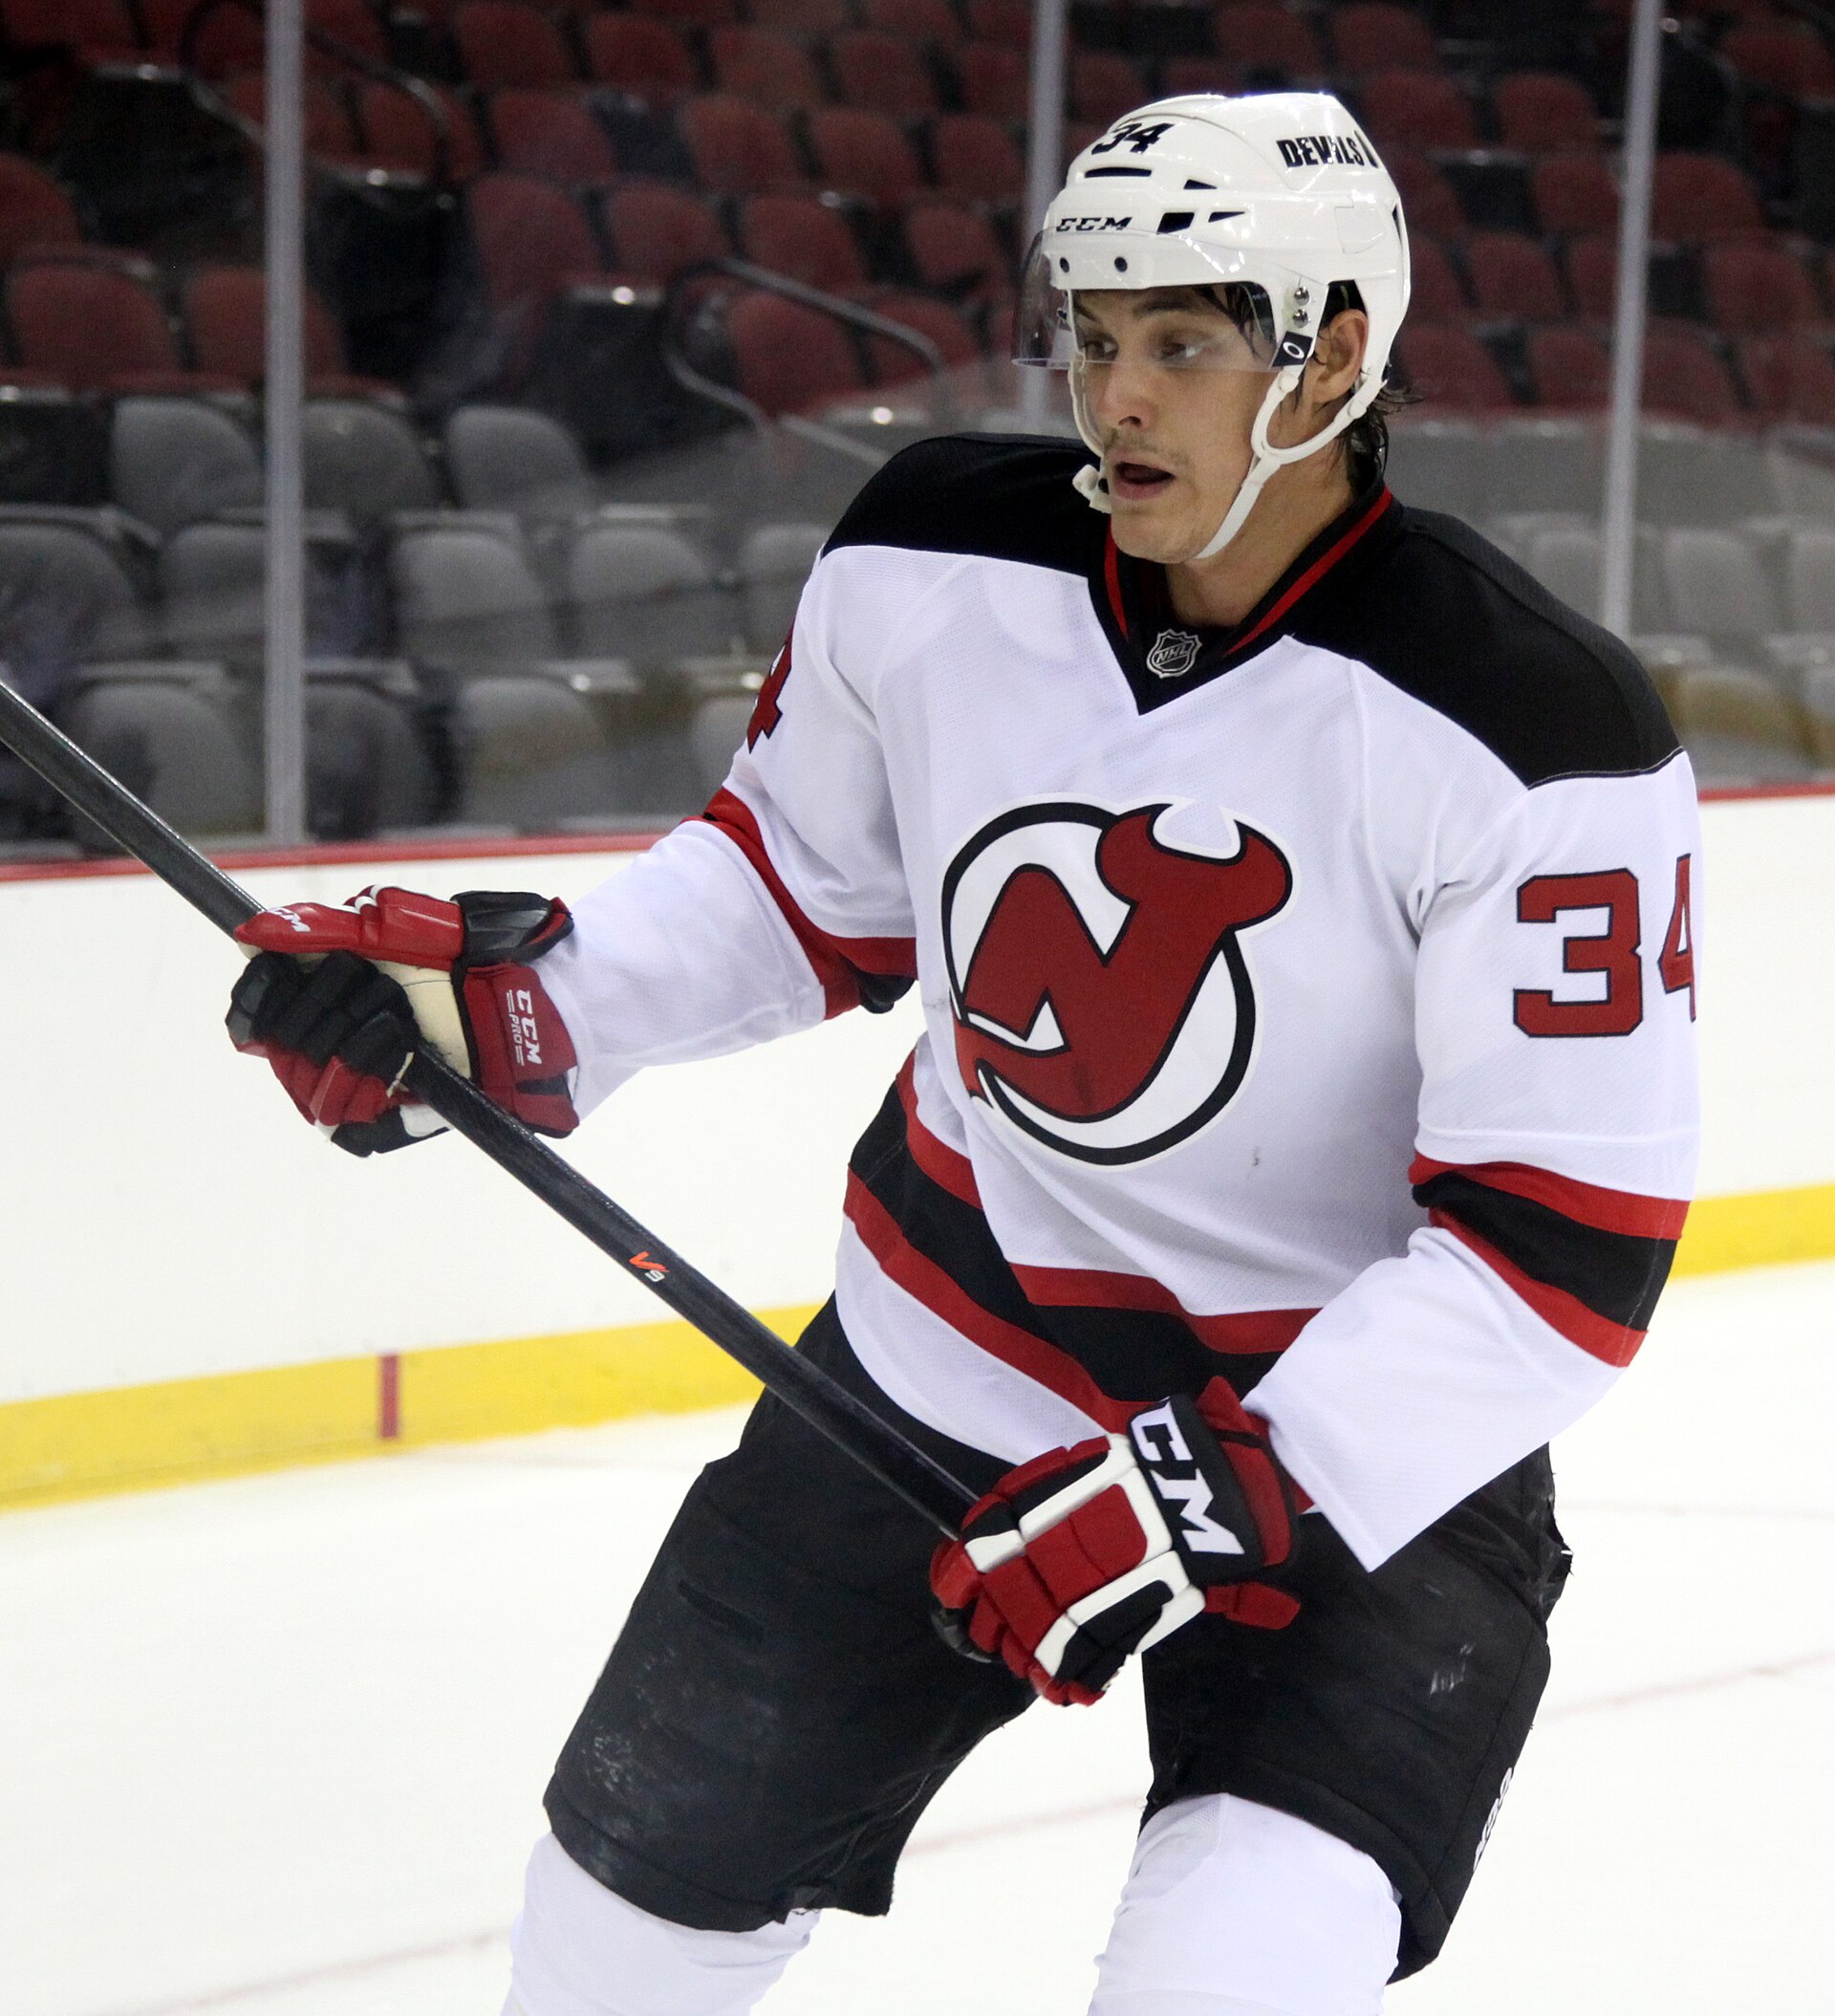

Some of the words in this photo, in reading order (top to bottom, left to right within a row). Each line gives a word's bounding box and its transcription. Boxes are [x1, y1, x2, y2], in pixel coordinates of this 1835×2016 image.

[1091, 122, 1175, 155] 34
[1276, 135, 1365, 167] DEVILS
[1056, 217, 1133, 231] CCM
[1155, 644, 1189, 663] NHL
[1513, 853, 1696, 1038] 34
[508, 1013, 523, 1045] PRO
[516, 989, 543, 1065] CCM
[1131, 1397, 1244, 1554] CM
